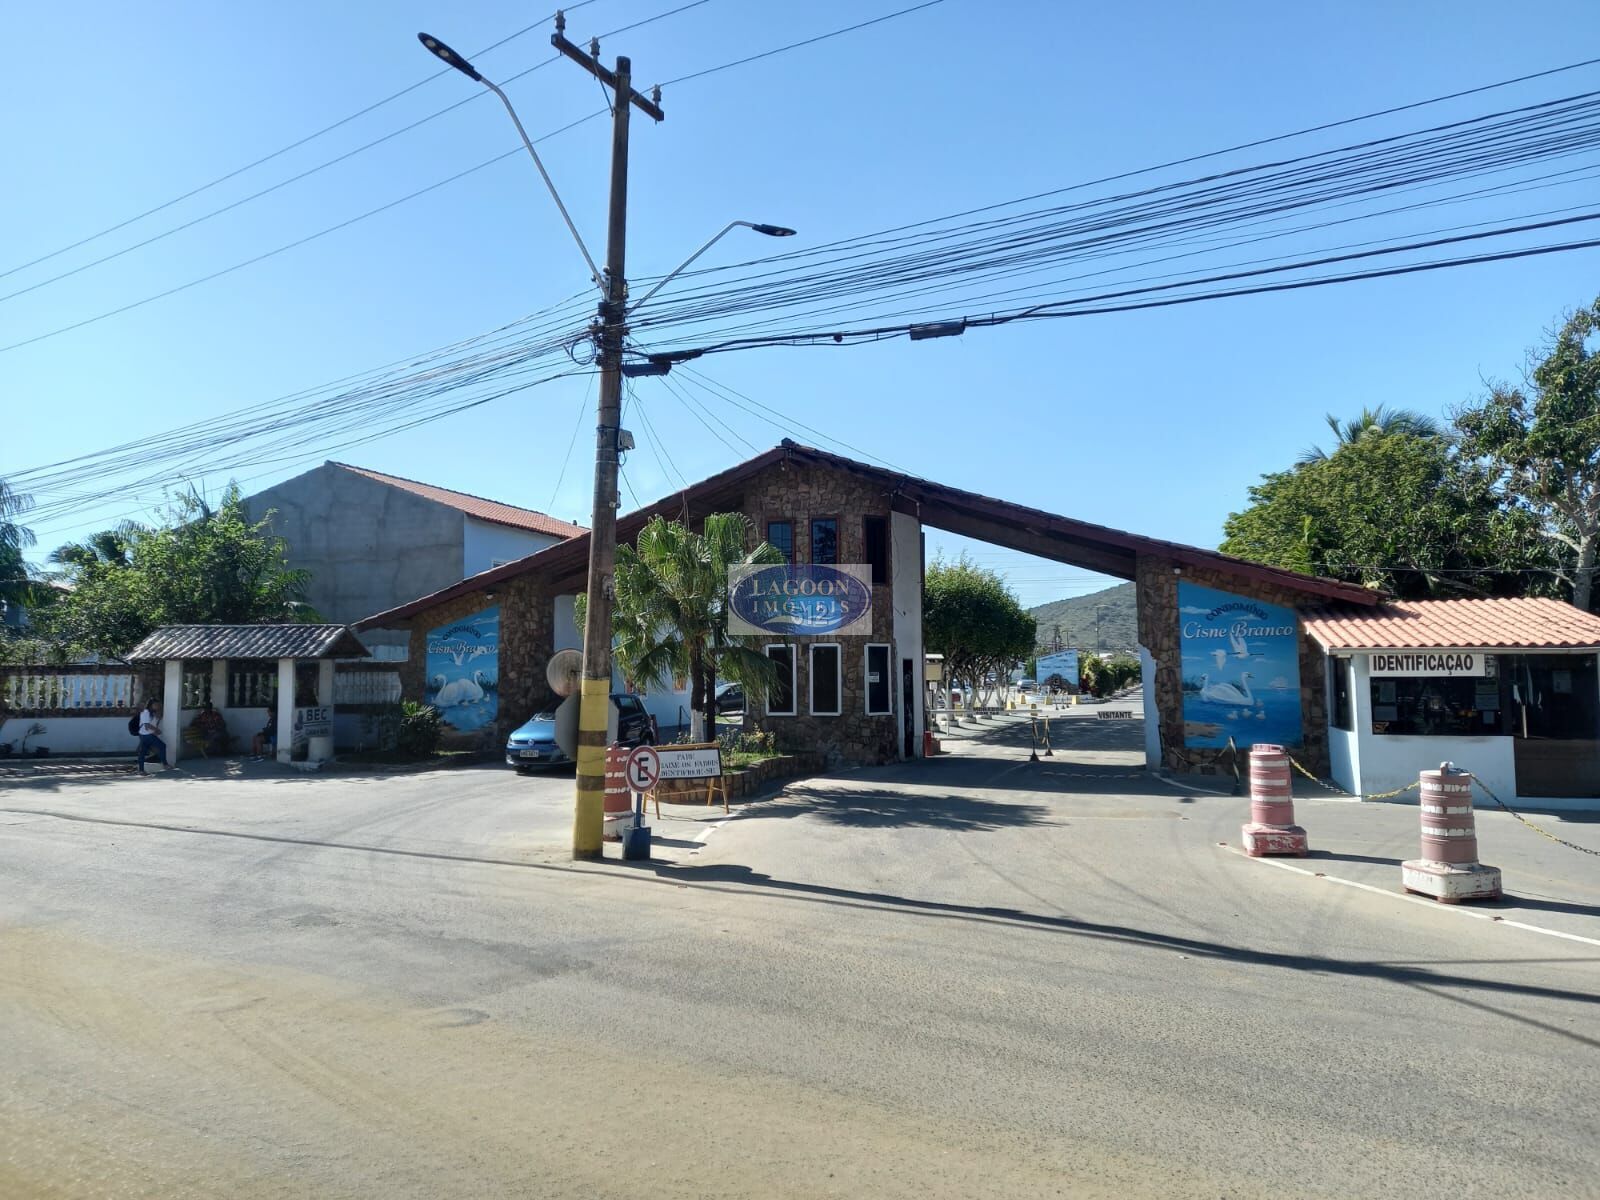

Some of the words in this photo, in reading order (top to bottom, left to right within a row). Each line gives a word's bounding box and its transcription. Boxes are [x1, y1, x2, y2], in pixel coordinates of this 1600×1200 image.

[1183, 621, 1227, 639] Cisne
[1231, 621, 1293, 638] Branco
[306, 708, 327, 721] BEC
[1098, 711, 1132, 719] VISITANTE
[638, 757, 649, 781] E
